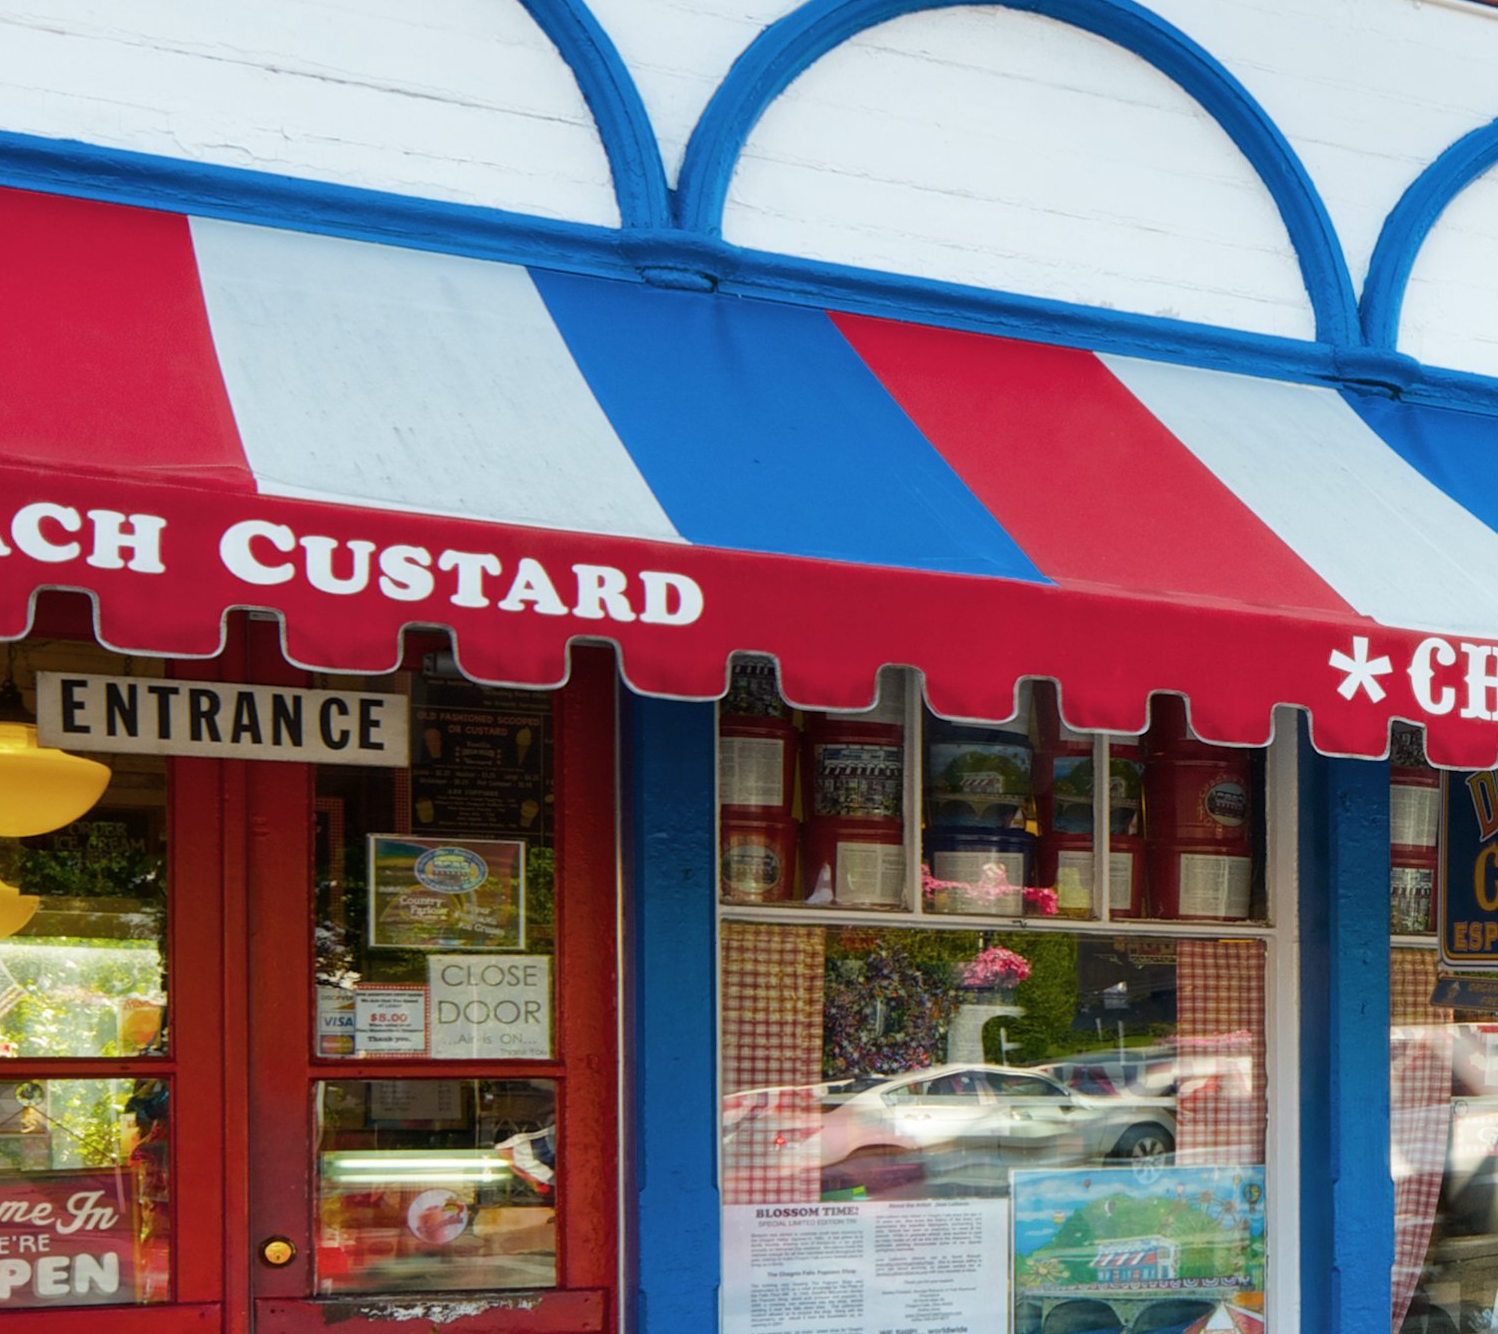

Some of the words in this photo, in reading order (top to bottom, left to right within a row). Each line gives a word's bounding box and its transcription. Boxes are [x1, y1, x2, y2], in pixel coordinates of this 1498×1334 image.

[218, 519, 705, 626] CUSTARD
[60, 678, 385, 751] ENTRANCE
[400, 895, 447, 908] Country
[440, 964, 538, 987] CLOSE
[370, 1012, 408, 1023] $5.00
[437, 1000, 542, 1025] DOOR
[324, 1017, 353, 1027] VISA
[367, 1035, 393, 1043] Thank
[482, 1034, 492, 1045] is
[55, 1190, 119, 1235] In
[755, 1207, 819, 1218] BLOSSOM
[822, 1206, 859, 1216] TIME!
[758, 1219, 788, 1227] SPECIAL
[789, 1219, 816, 1227] LIMITED
[817, 1218, 845, 1226] EDITION
[928, 1326, 968, 1334] worldwide
